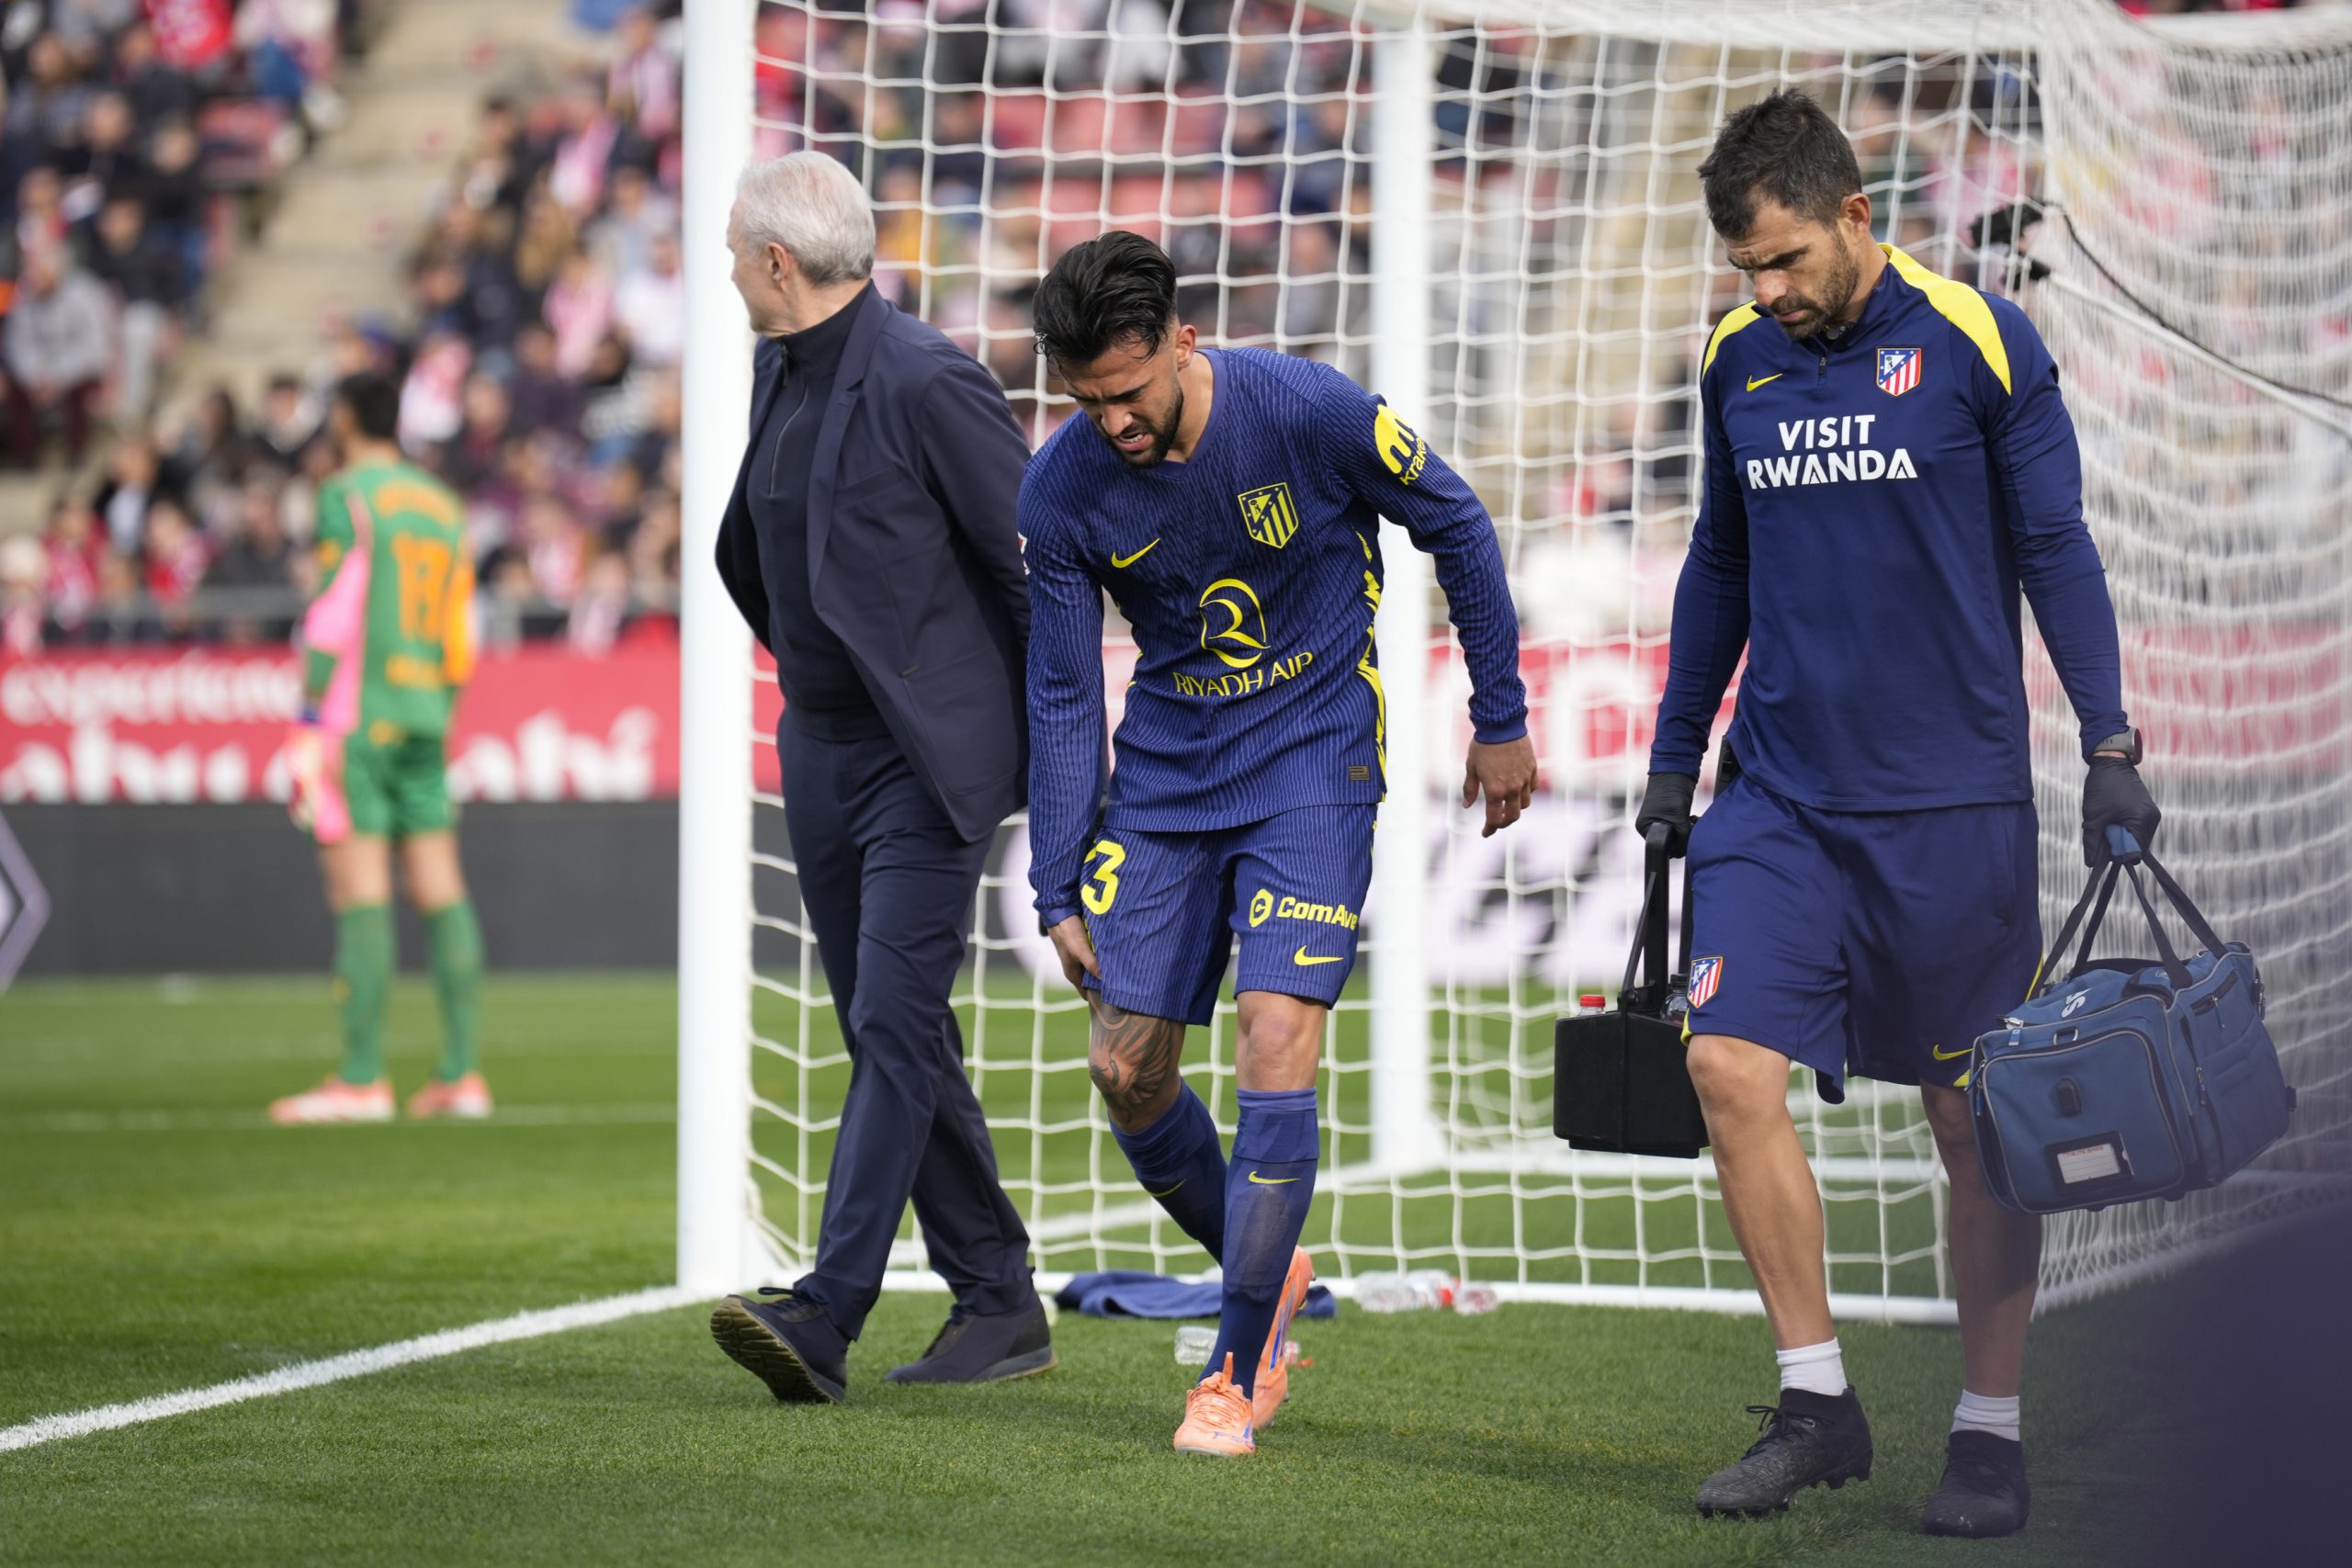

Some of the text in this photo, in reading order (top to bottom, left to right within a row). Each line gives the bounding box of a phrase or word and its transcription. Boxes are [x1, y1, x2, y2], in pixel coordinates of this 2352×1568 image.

[1778, 414, 1876, 451] VISIT
[1399, 436, 1427, 486] krake
[1747, 448, 1918, 490] RWANDA
[1172, 669, 1263, 696] RIYADH
